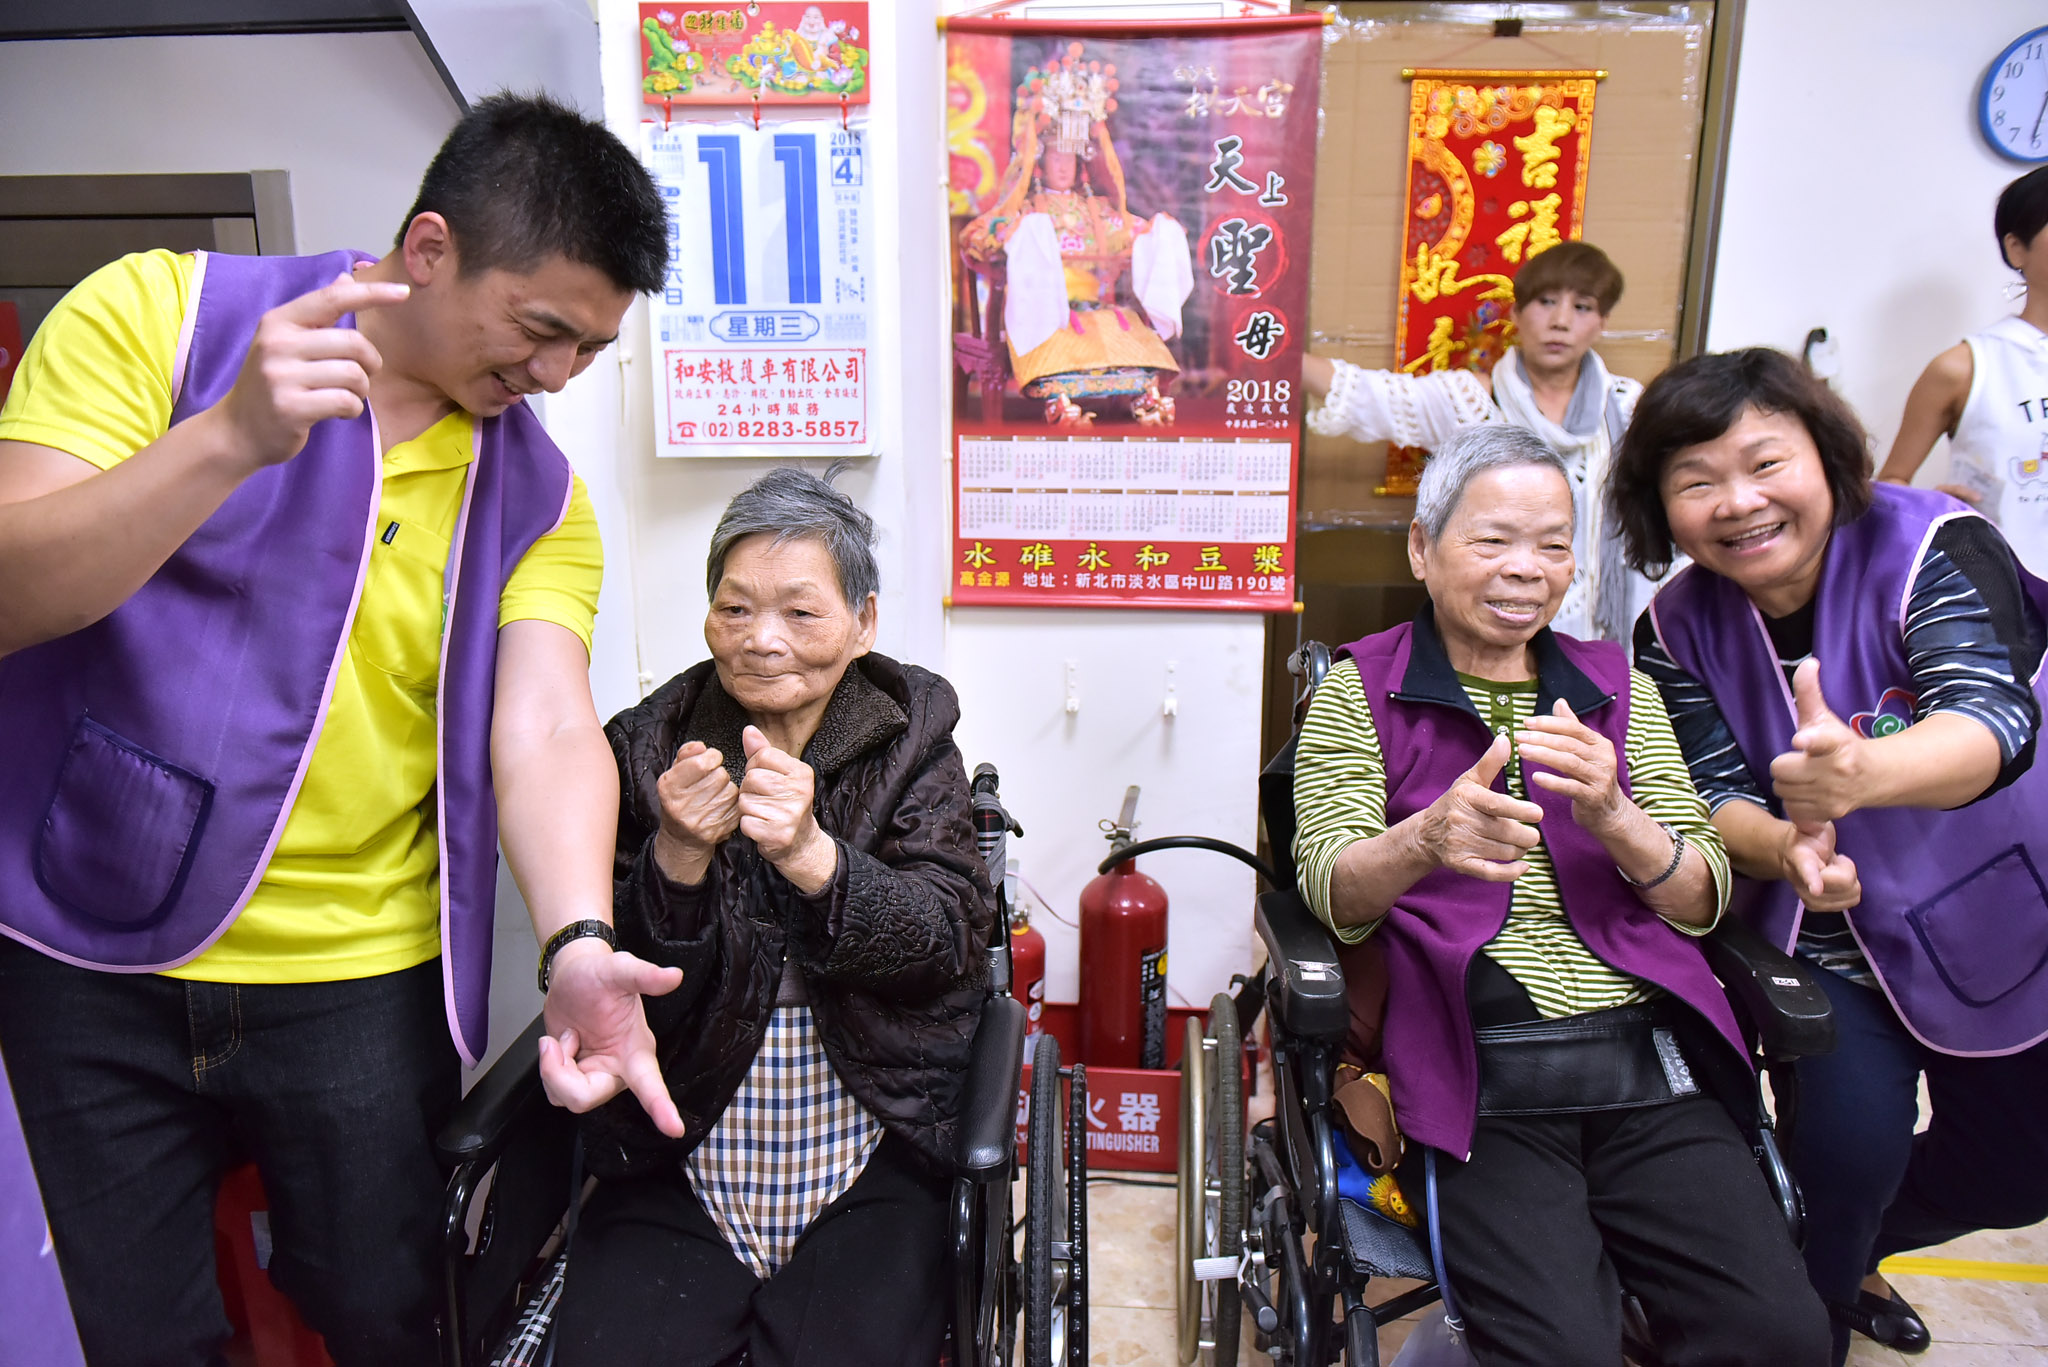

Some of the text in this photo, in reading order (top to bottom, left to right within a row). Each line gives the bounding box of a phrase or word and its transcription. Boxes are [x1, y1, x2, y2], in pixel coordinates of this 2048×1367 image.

[2025, 43, 2043, 60] 11
[2004, 61, 2024, 79] 10
[1993, 85, 2005, 102] 9
[1993, 109, 2006, 126] 8
[829, 132, 862, 146] 2018
[2008, 126, 2021, 143] 7
[835, 157, 854, 184] 4
[696, 134, 823, 304] 11
[1204, 134, 1289, 360] 天上聖母
[728, 315, 802, 337] 星期三
[1226, 379, 1291, 403] 2018
[717, 402, 820, 416] 24小時服務
[963, 541, 1286, 576] 水碓永和豆漿
[959, 570, 1010, 587] 高金源
[1085, 1131, 1161, 1154] TINGUISHER
